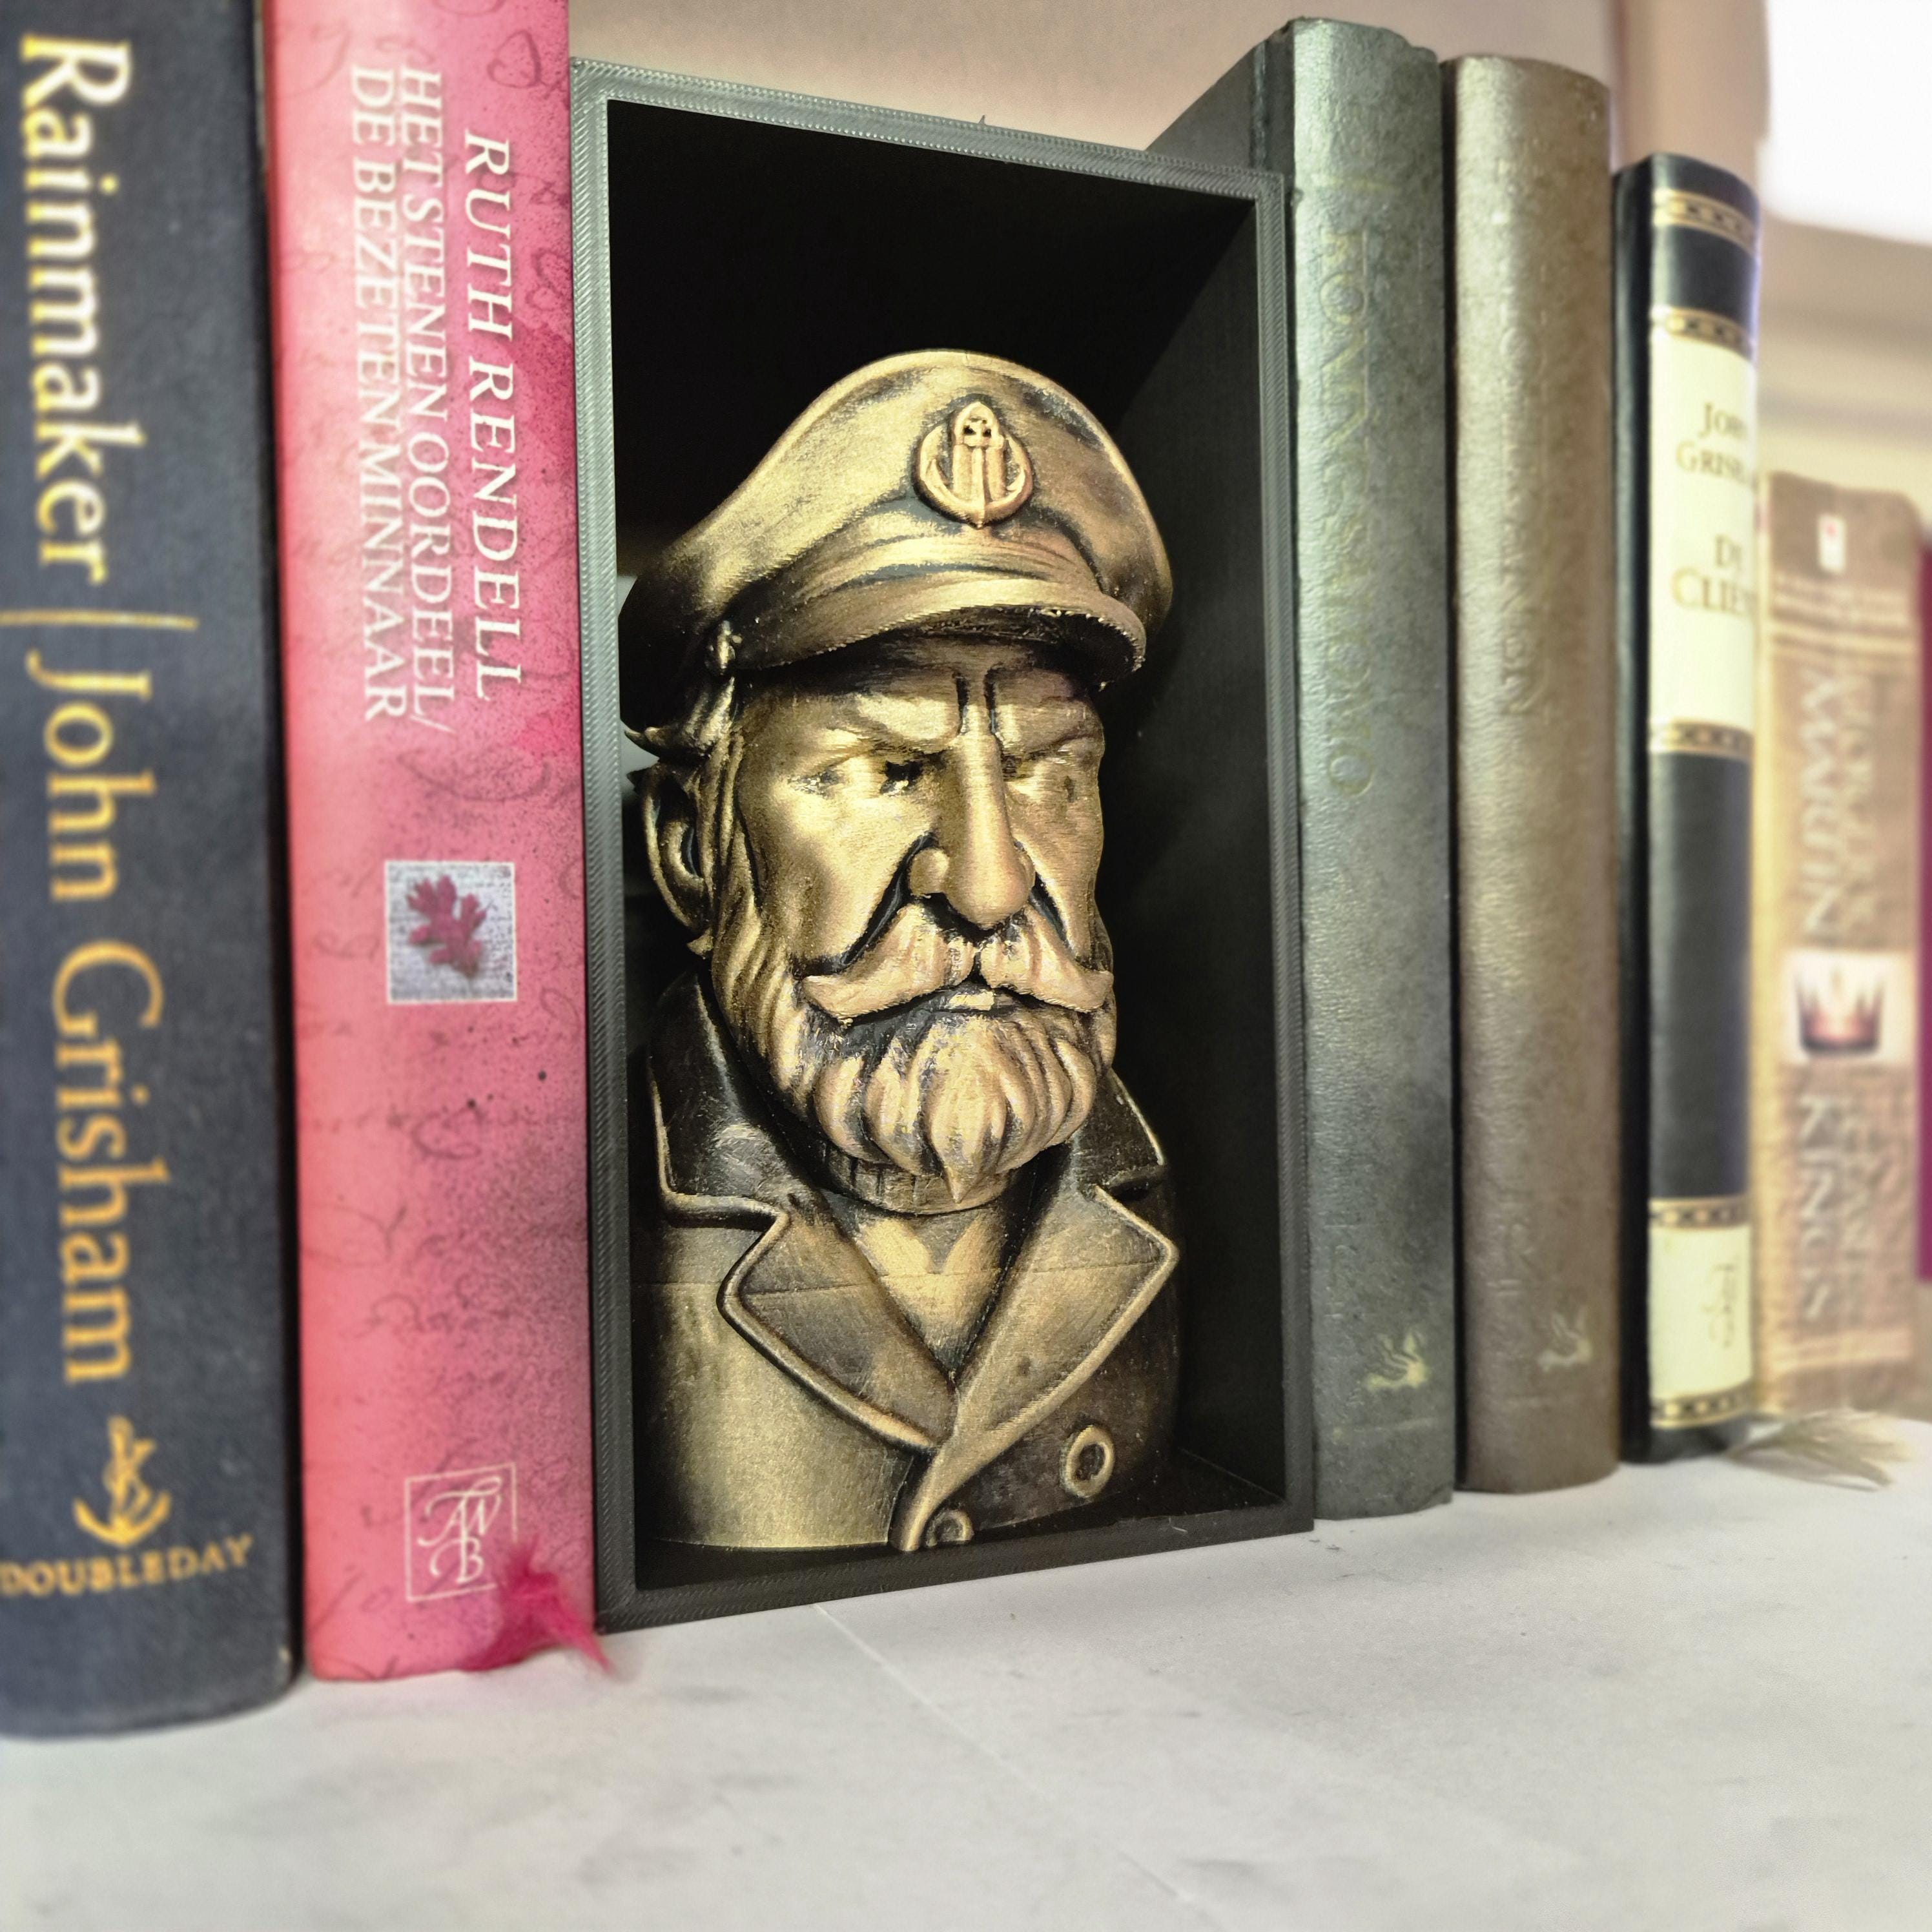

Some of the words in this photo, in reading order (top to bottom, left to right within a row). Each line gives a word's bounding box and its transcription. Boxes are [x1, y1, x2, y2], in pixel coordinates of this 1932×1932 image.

[351, 66, 396, 147] DE
[398, 66, 444, 189] HET
[20, 32, 146, 585] Rainmaker
[353, 157, 402, 433] BEZETEN
[401, 193, 447, 423] STENEN
[464, 127, 513, 342] RUTH
[358, 439, 408, 723] MINNAAR
[468, 356, 522, 702] RENDELL
[25, 648, 156, 901] John
[52, 938, 170, 1384] Grisham
[0, 1532, 254, 1598] DOUBLEDAY
